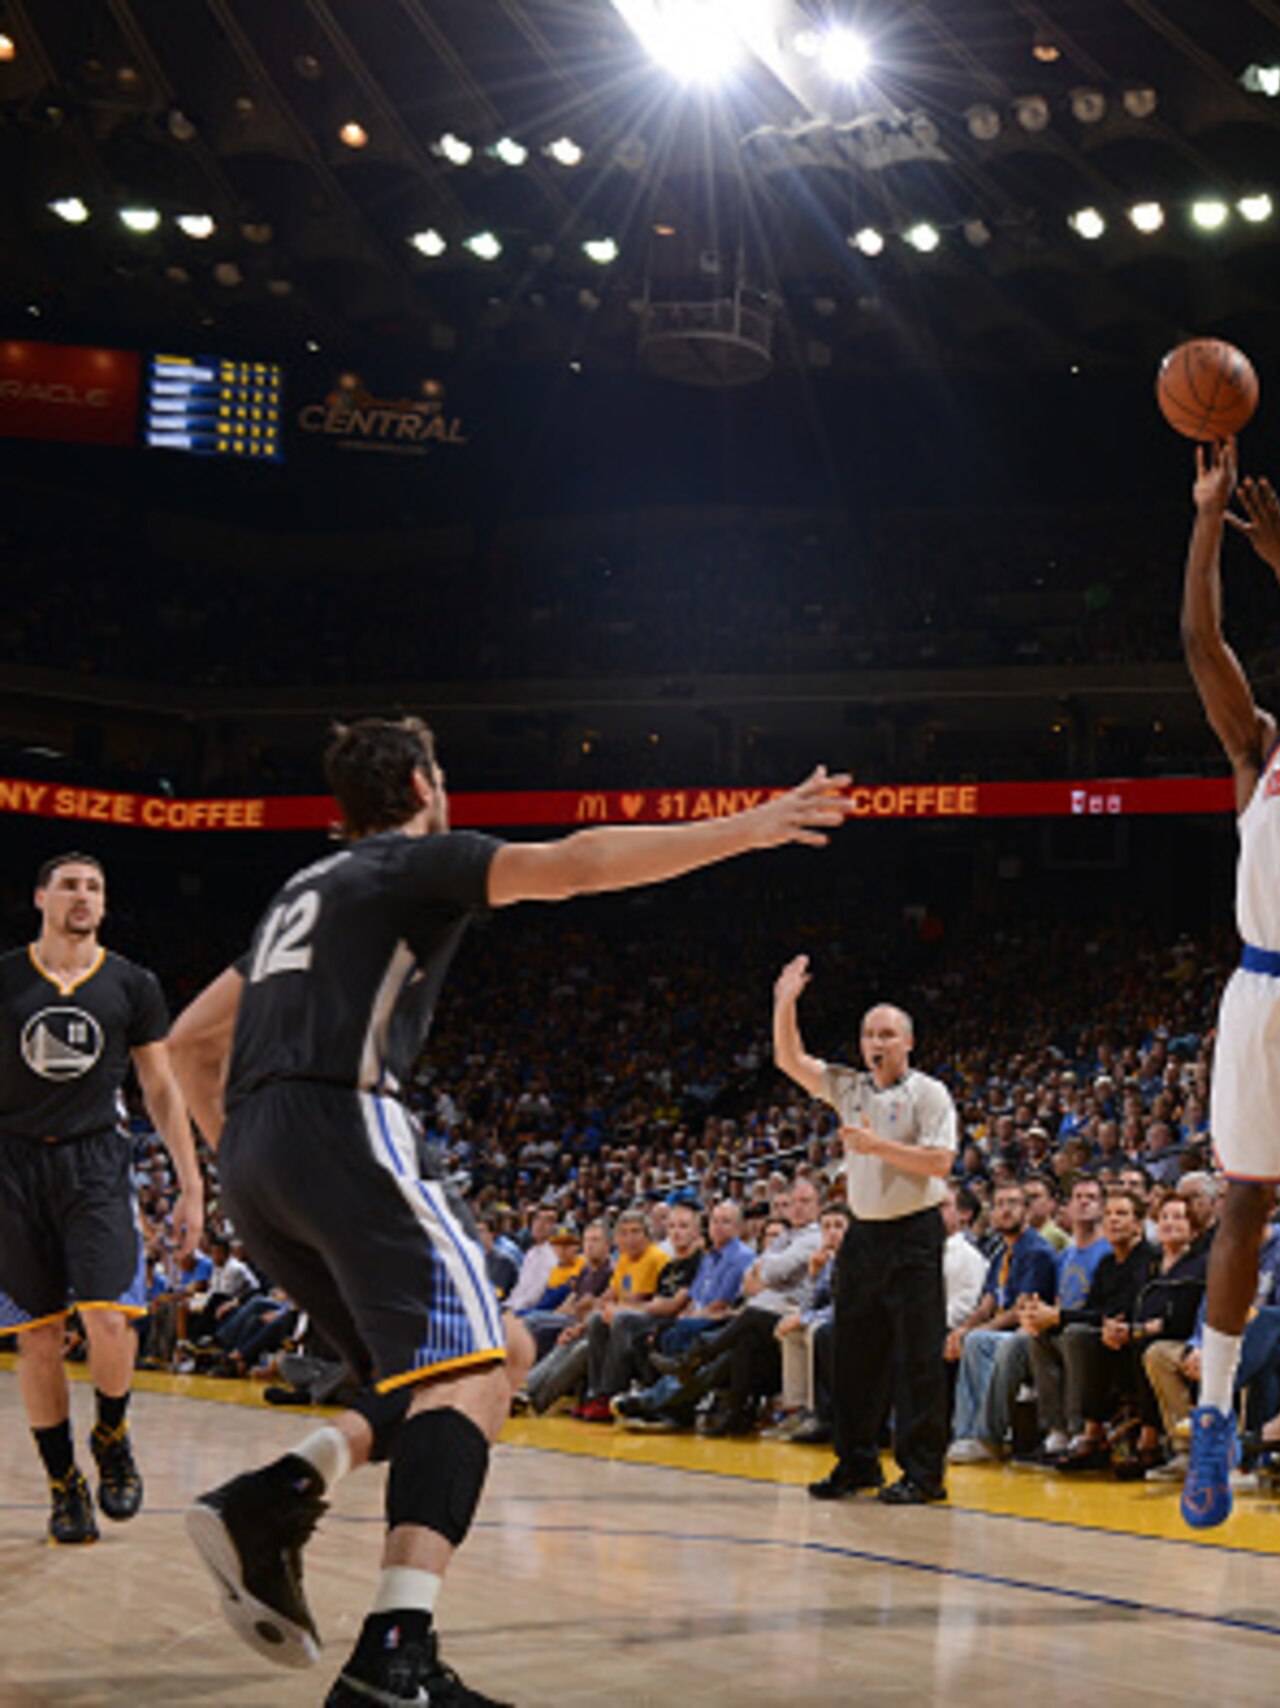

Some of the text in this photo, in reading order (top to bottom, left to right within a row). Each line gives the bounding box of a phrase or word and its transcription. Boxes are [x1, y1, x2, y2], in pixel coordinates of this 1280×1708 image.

[298, 405, 467, 444] CENTRAL
[55, 788, 134, 823] SIZE
[142, 799, 265, 827] COFFEE
[657, 790, 686, 818] $1
[851, 786, 978, 815] COFFEE
[250, 890, 320, 983] 12
